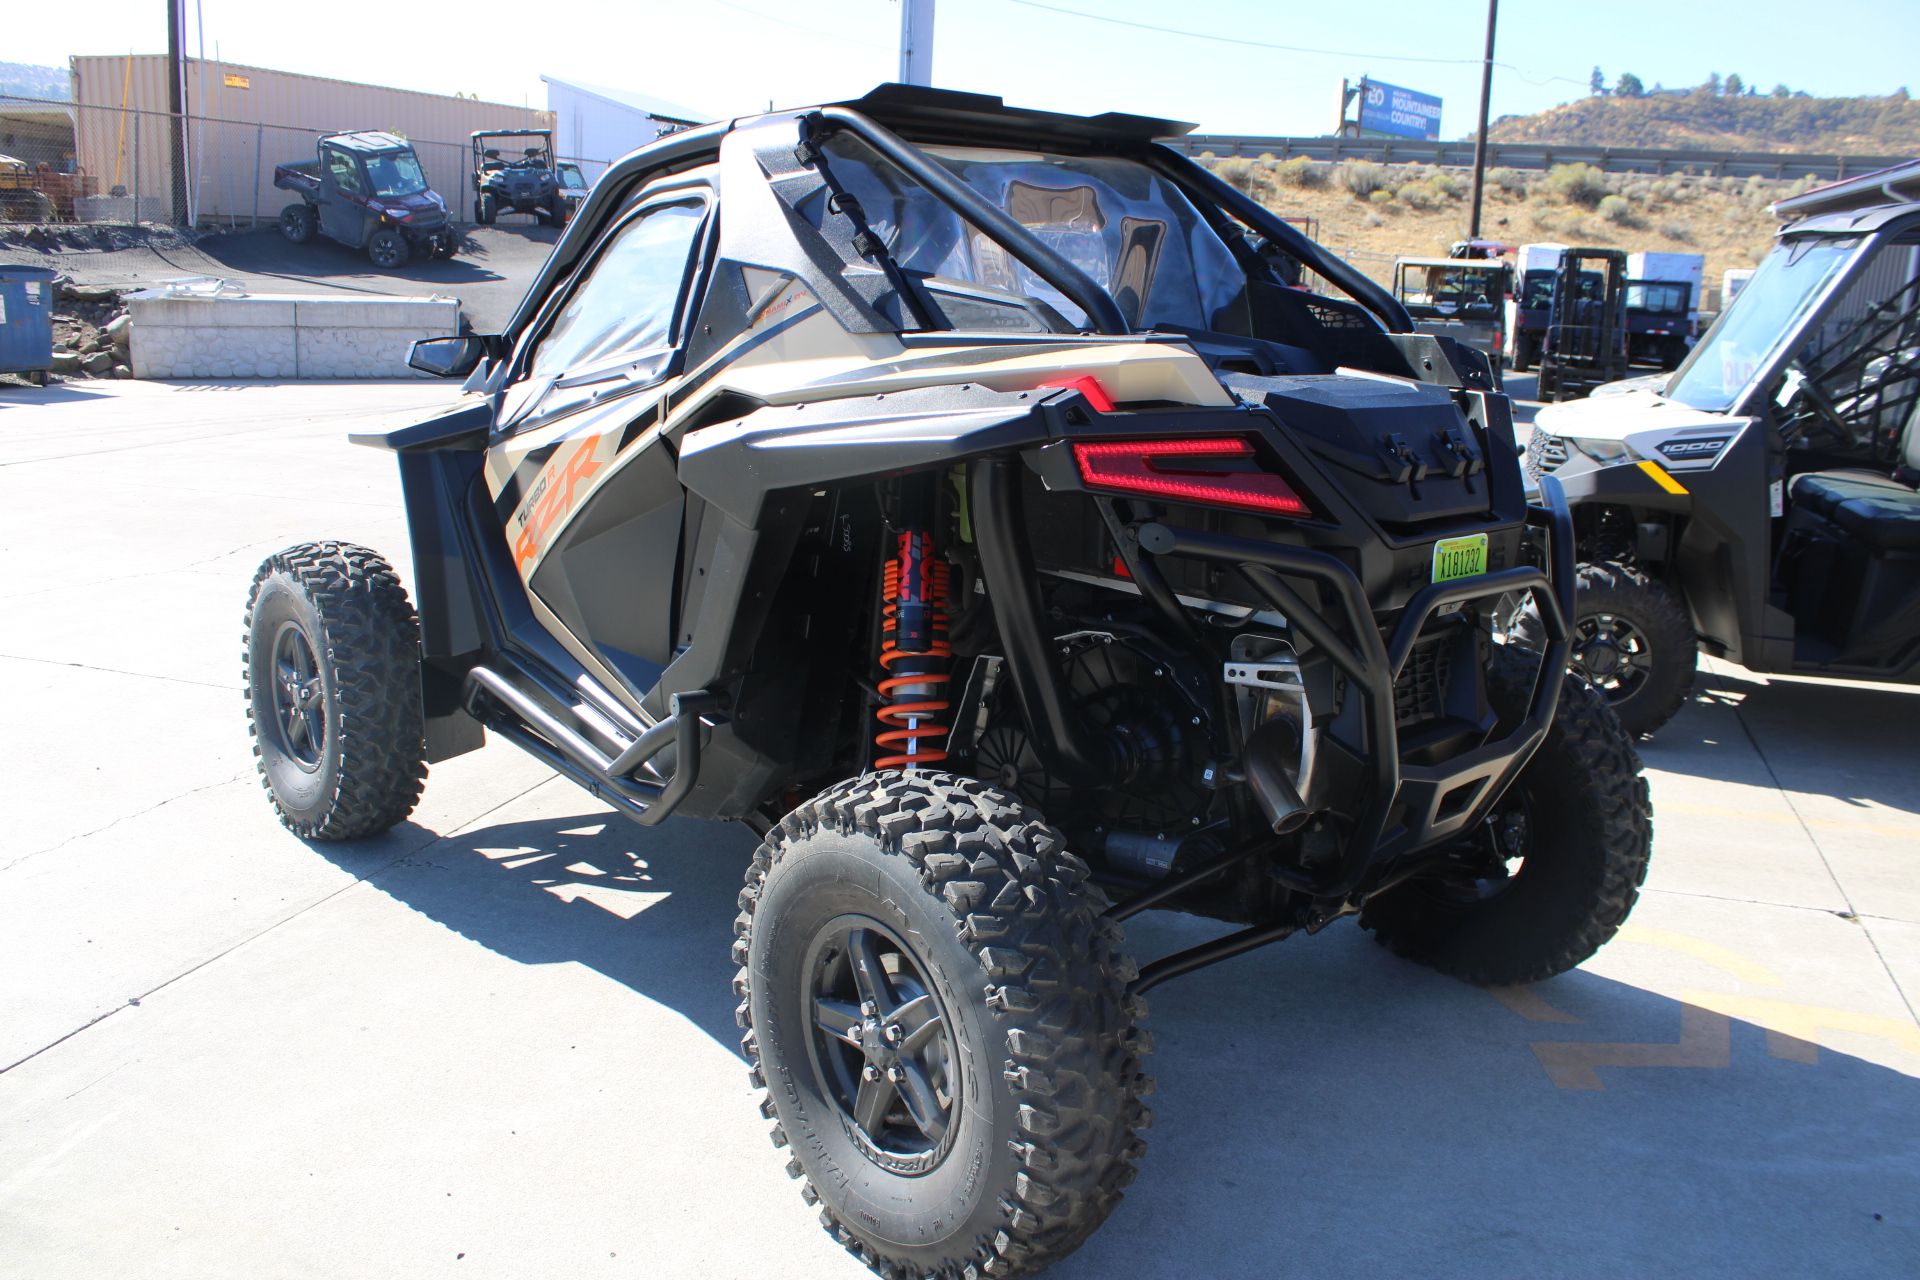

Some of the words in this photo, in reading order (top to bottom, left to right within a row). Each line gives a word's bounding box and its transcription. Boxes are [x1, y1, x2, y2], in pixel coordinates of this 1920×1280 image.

[1391, 110, 1427, 130] COUNTRY!
[1662, 440, 1725, 453] 1000
[515, 433, 605, 576] RZR
[517, 480, 547, 528] TURBO
[546, 464, 557, 488] R
[1440, 547, 1481, 579] X181232
